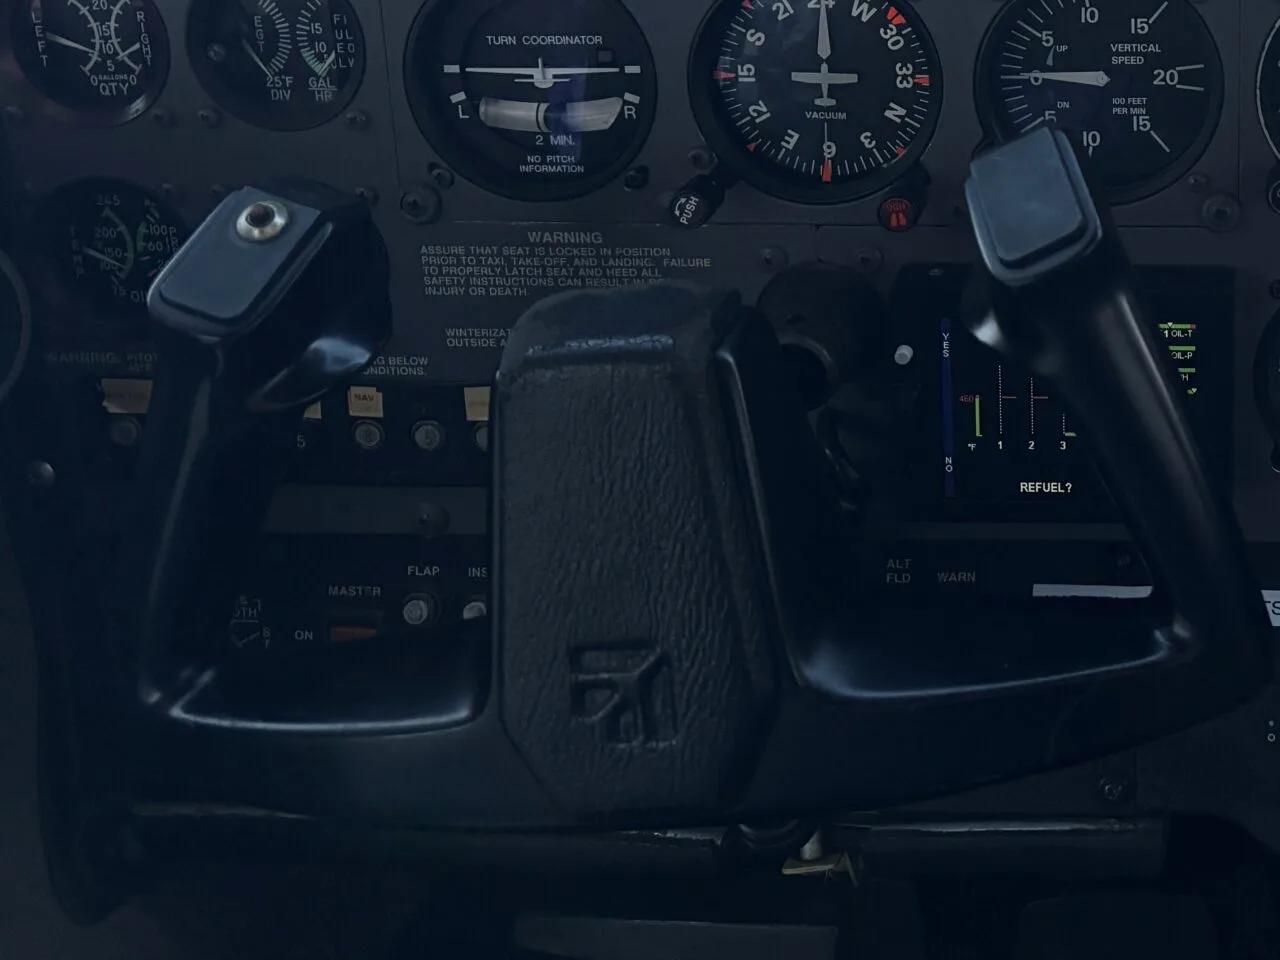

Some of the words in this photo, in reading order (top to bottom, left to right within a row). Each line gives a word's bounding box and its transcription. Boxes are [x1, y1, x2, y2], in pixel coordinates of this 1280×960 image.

[1081, 8, 1100, 24] 10
[1130, 19, 1150, 35] 15
[486, 36, 517, 45] TURN
[522, 36, 603, 45] COORDINATOR
[1110, 43, 1162, 53] VERTICAL
[1112, 56, 1145, 65] SPEED
[1154, 70, 1179, 86] 20
[100, 83, 129, 96] QTY
[805, 111, 847, 120] VACUUM
[527, 155, 541, 164] NO
[547, 155, 575, 164] PITCH
[519, 165, 585, 174] INFORMATION
[528, 232, 603, 244] WARNING
[421, 246, 466, 256] ASSURE
[470, 246, 498, 256] THAT
[503, 247, 531, 256] SEAT
[536, 247, 546, 256] IS
[550, 247, 596, 256] LOCKED
[601, 247, 611, 256] IN
[616, 247, 670, 257] POSITION
[1020, 480, 1072, 495] REFUEL?
[887, 559, 911, 569] ALT
[407, 566, 440, 577] FLAP
[887, 573, 911, 583] FLD
[937, 572, 977, 583] WARN
[328, 586, 381, 597] MASTER
[295, 630, 313, 640] ON
